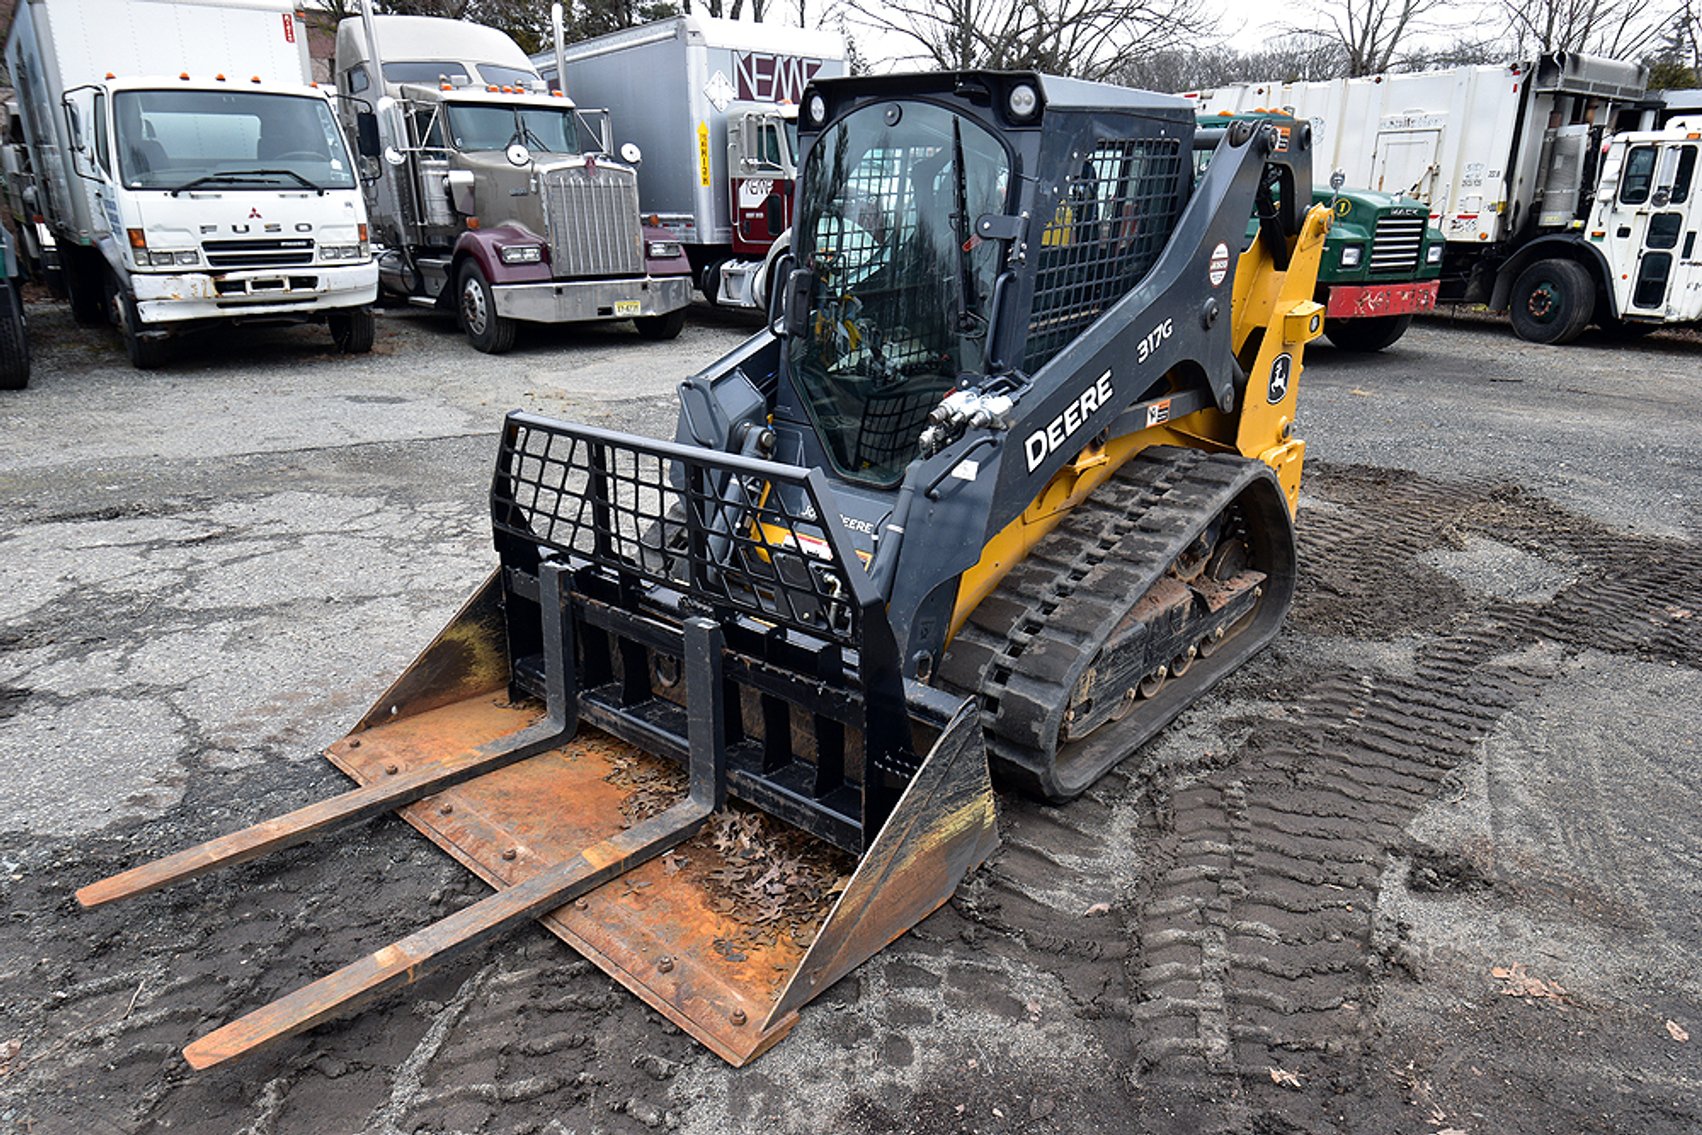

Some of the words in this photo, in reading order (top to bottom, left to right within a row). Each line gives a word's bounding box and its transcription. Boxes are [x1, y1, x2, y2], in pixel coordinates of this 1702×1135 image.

[1390, 208, 1419, 216] MACK
[199, 223, 313, 234] FUSO
[1137, 318, 1173, 364] 317G
[1025, 369, 1114, 473] DEERE
